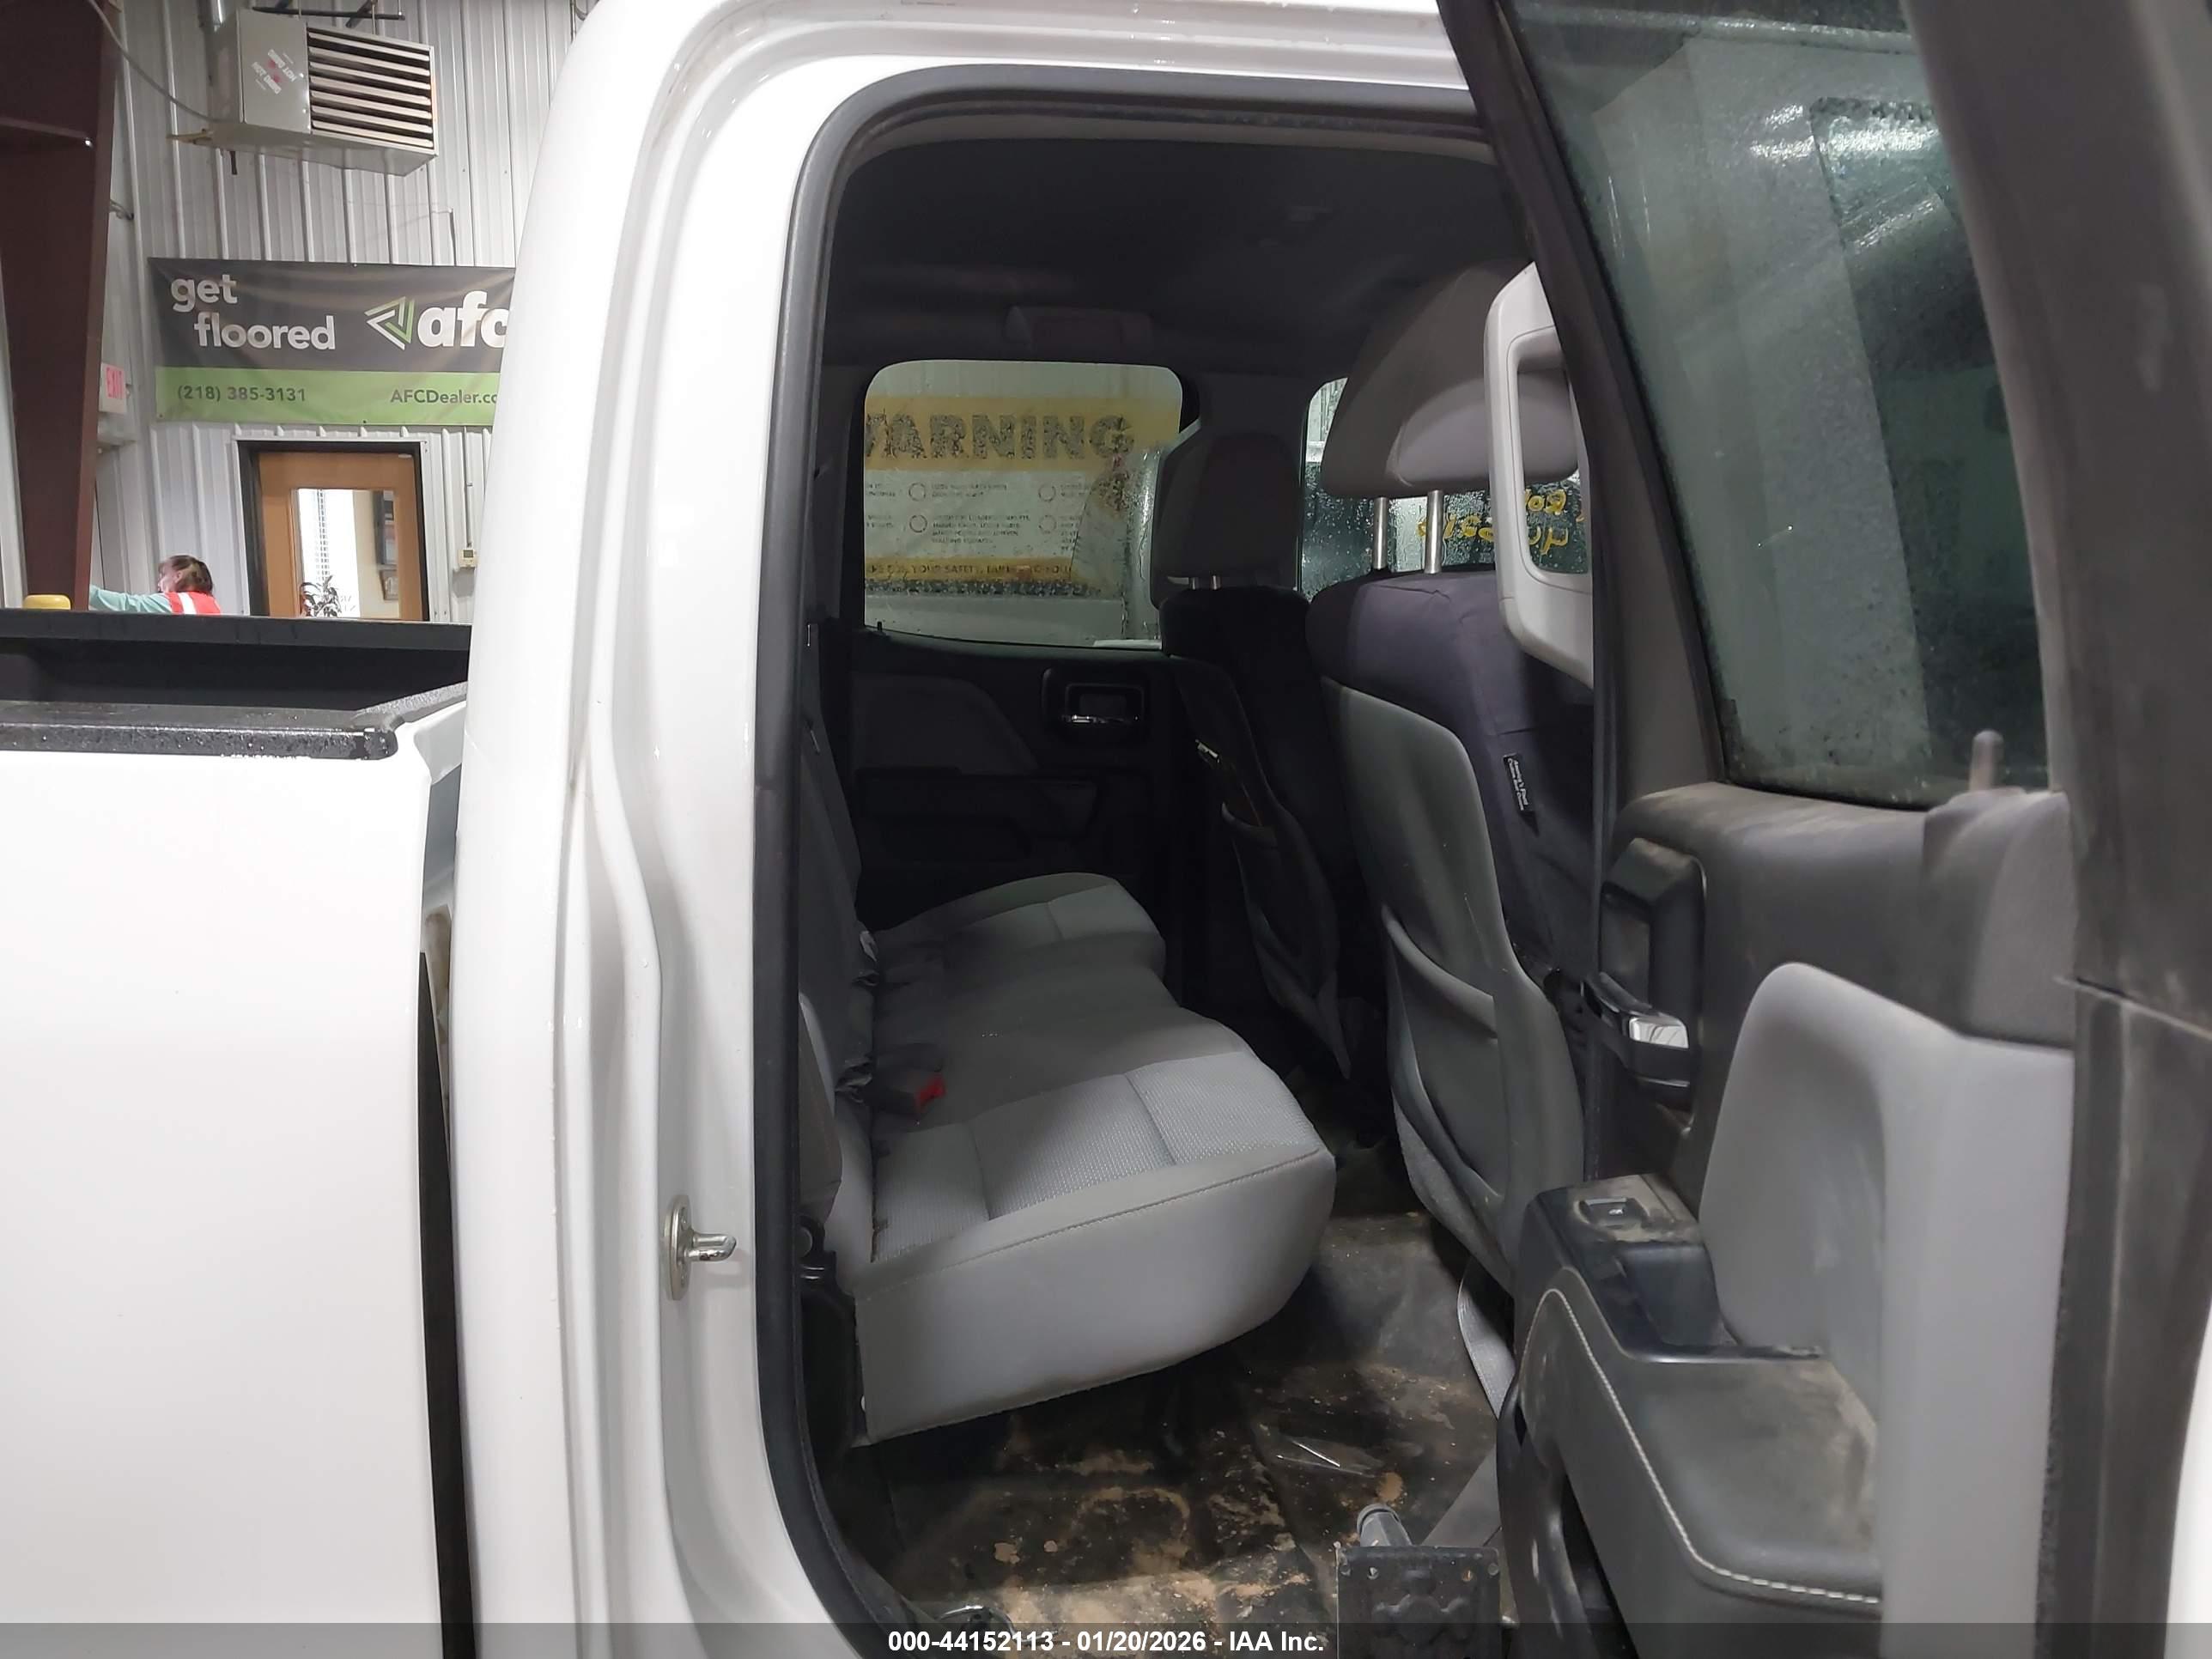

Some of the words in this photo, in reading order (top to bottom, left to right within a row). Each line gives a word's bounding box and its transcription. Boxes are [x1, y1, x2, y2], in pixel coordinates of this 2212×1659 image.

[171, 274, 238, 313] get
[193, 312, 336, 350] floored
[417, 290, 509, 349] afc
[178, 386, 221, 402] (218)
[227, 386, 306, 402] 385-3131
